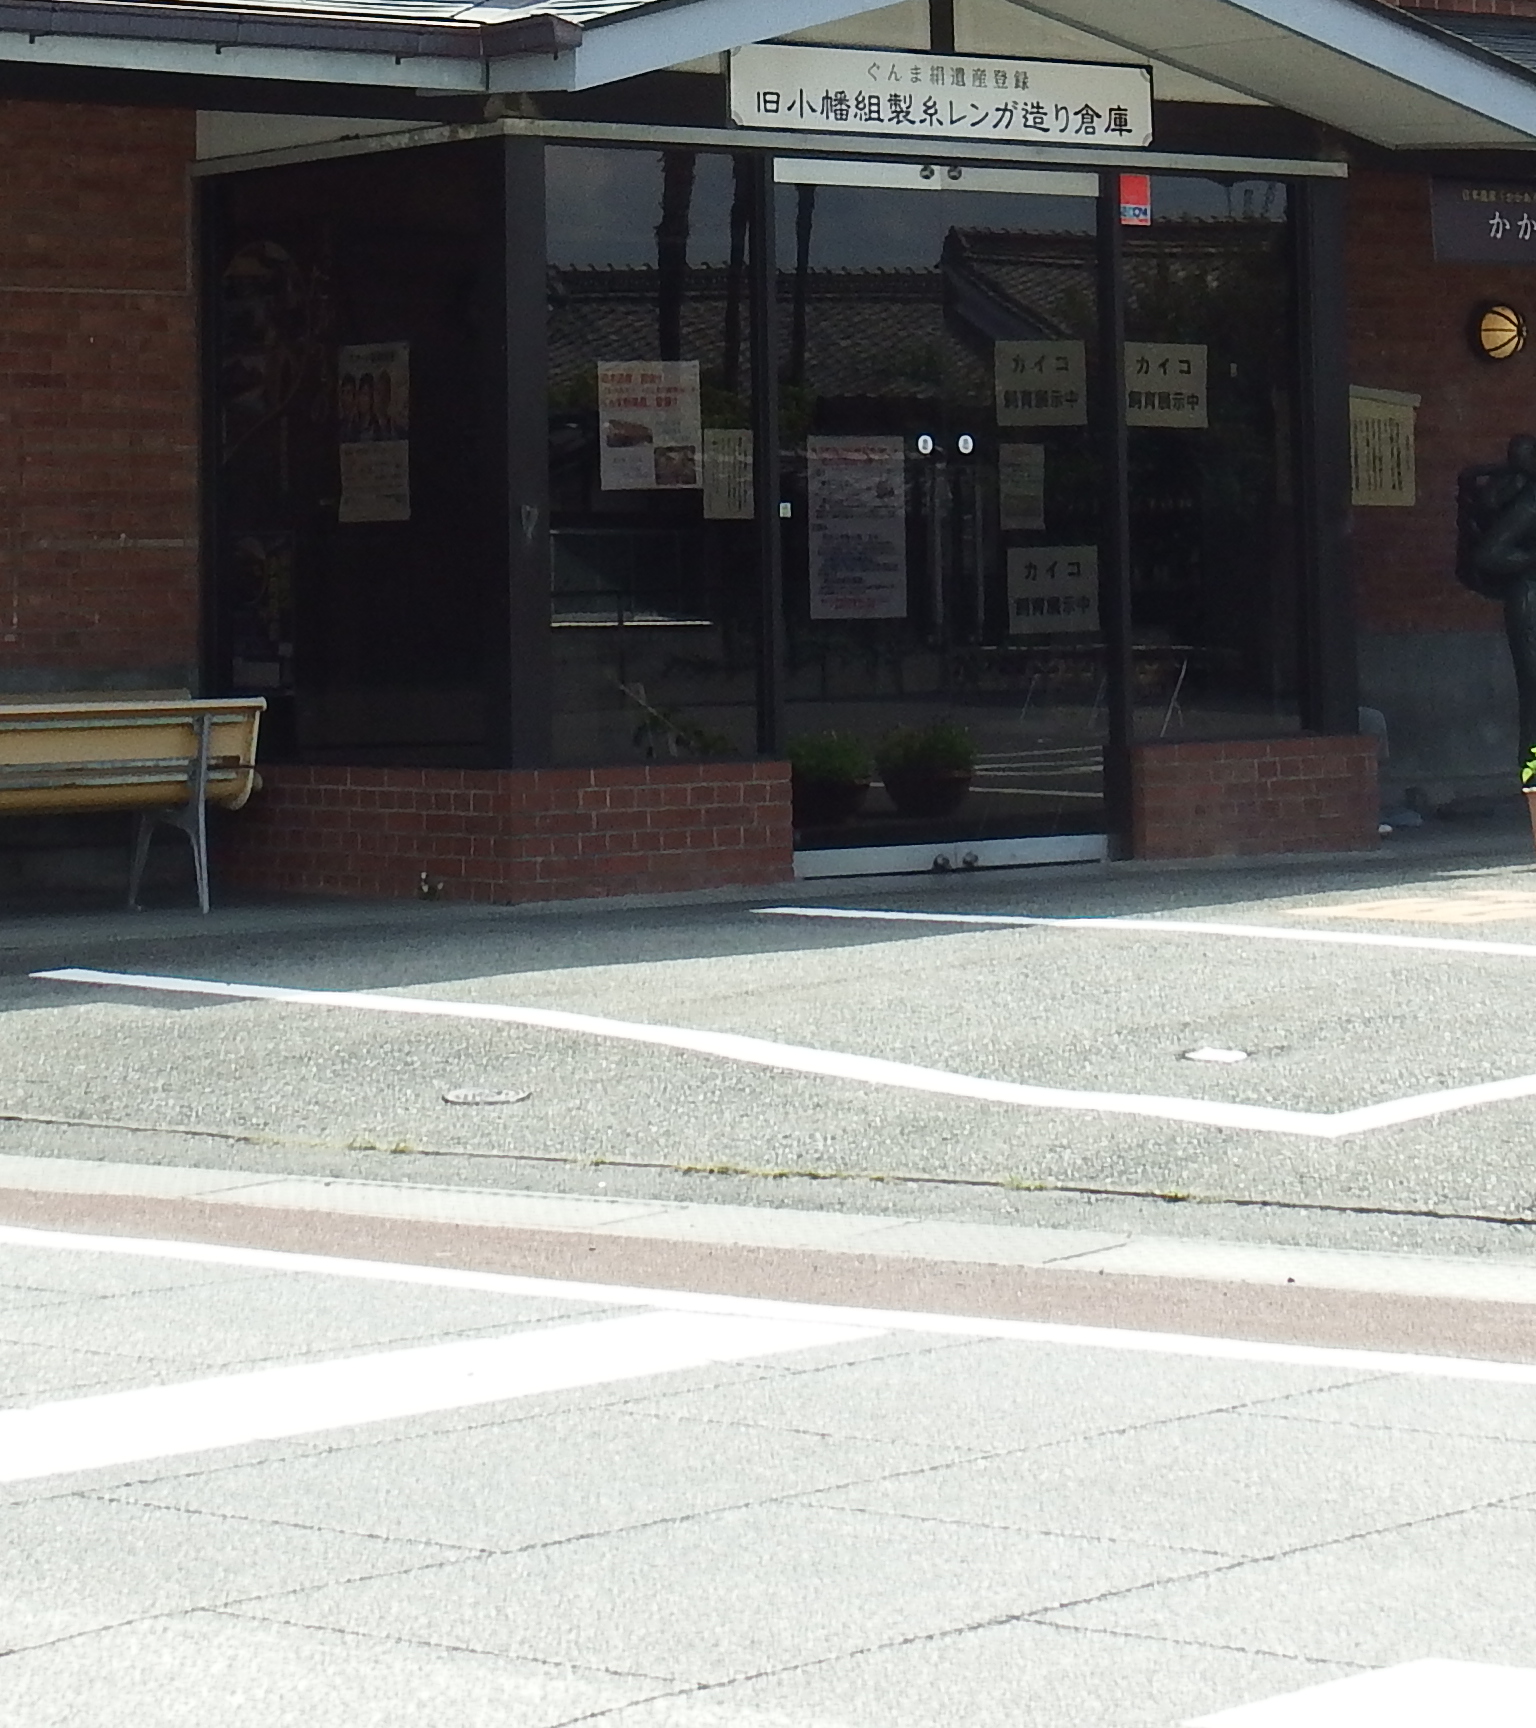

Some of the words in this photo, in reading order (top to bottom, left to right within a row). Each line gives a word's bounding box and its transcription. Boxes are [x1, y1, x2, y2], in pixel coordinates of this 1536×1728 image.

[867, 62, 1030, 89] ぐんま絹遺産登録
[756, 88, 1133, 135] 旧小幡組製糸レンガ造り倉庫
[1012, 353, 1070, 374] カイコ
[1135, 356, 1193, 376] カイコ
[1023, 560, 1082, 582] カイコ
